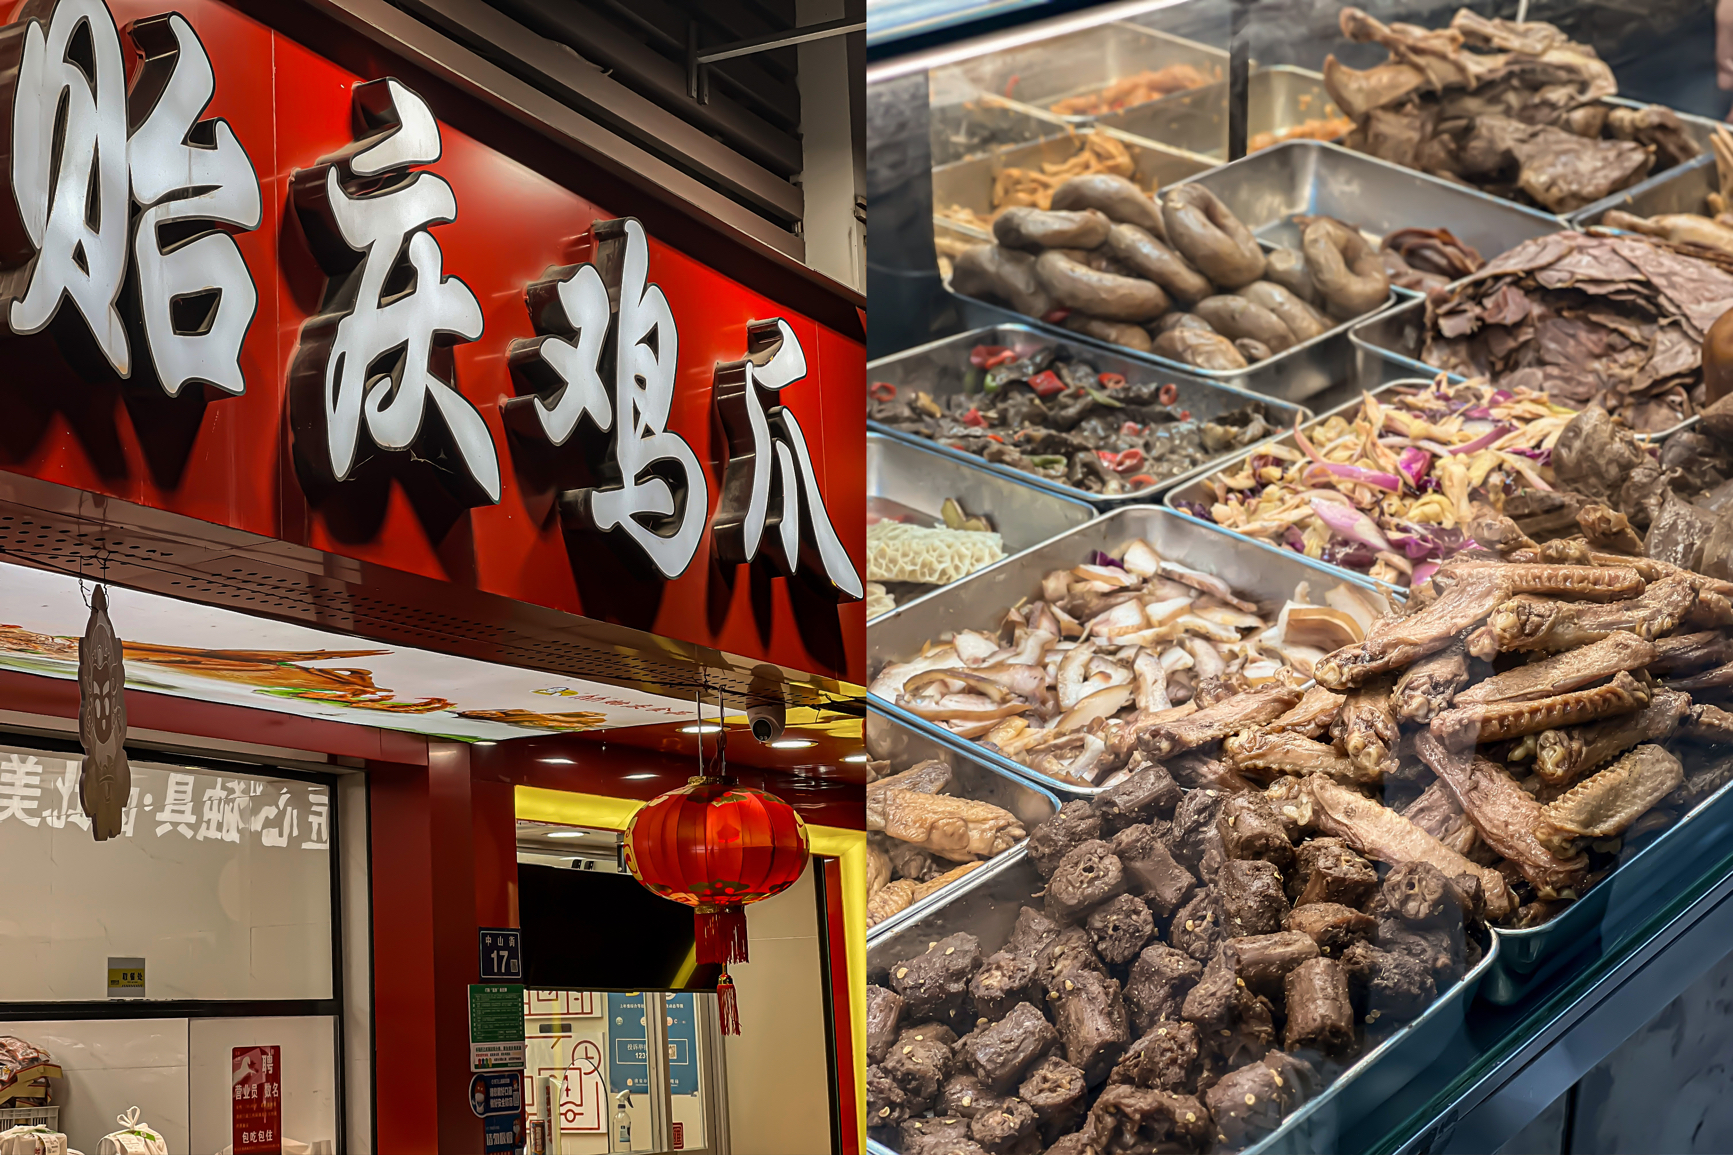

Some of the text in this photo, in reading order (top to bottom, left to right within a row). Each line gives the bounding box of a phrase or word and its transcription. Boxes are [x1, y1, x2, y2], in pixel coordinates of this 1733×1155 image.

[485, 934, 516, 947] 中山街
[490, 950, 509, 973] 17
[261, 1054, 274, 1075] 聘
[234, 1082, 279, 1101] 营业员 数名
[242, 1129, 273, 1144] 包吃包住
